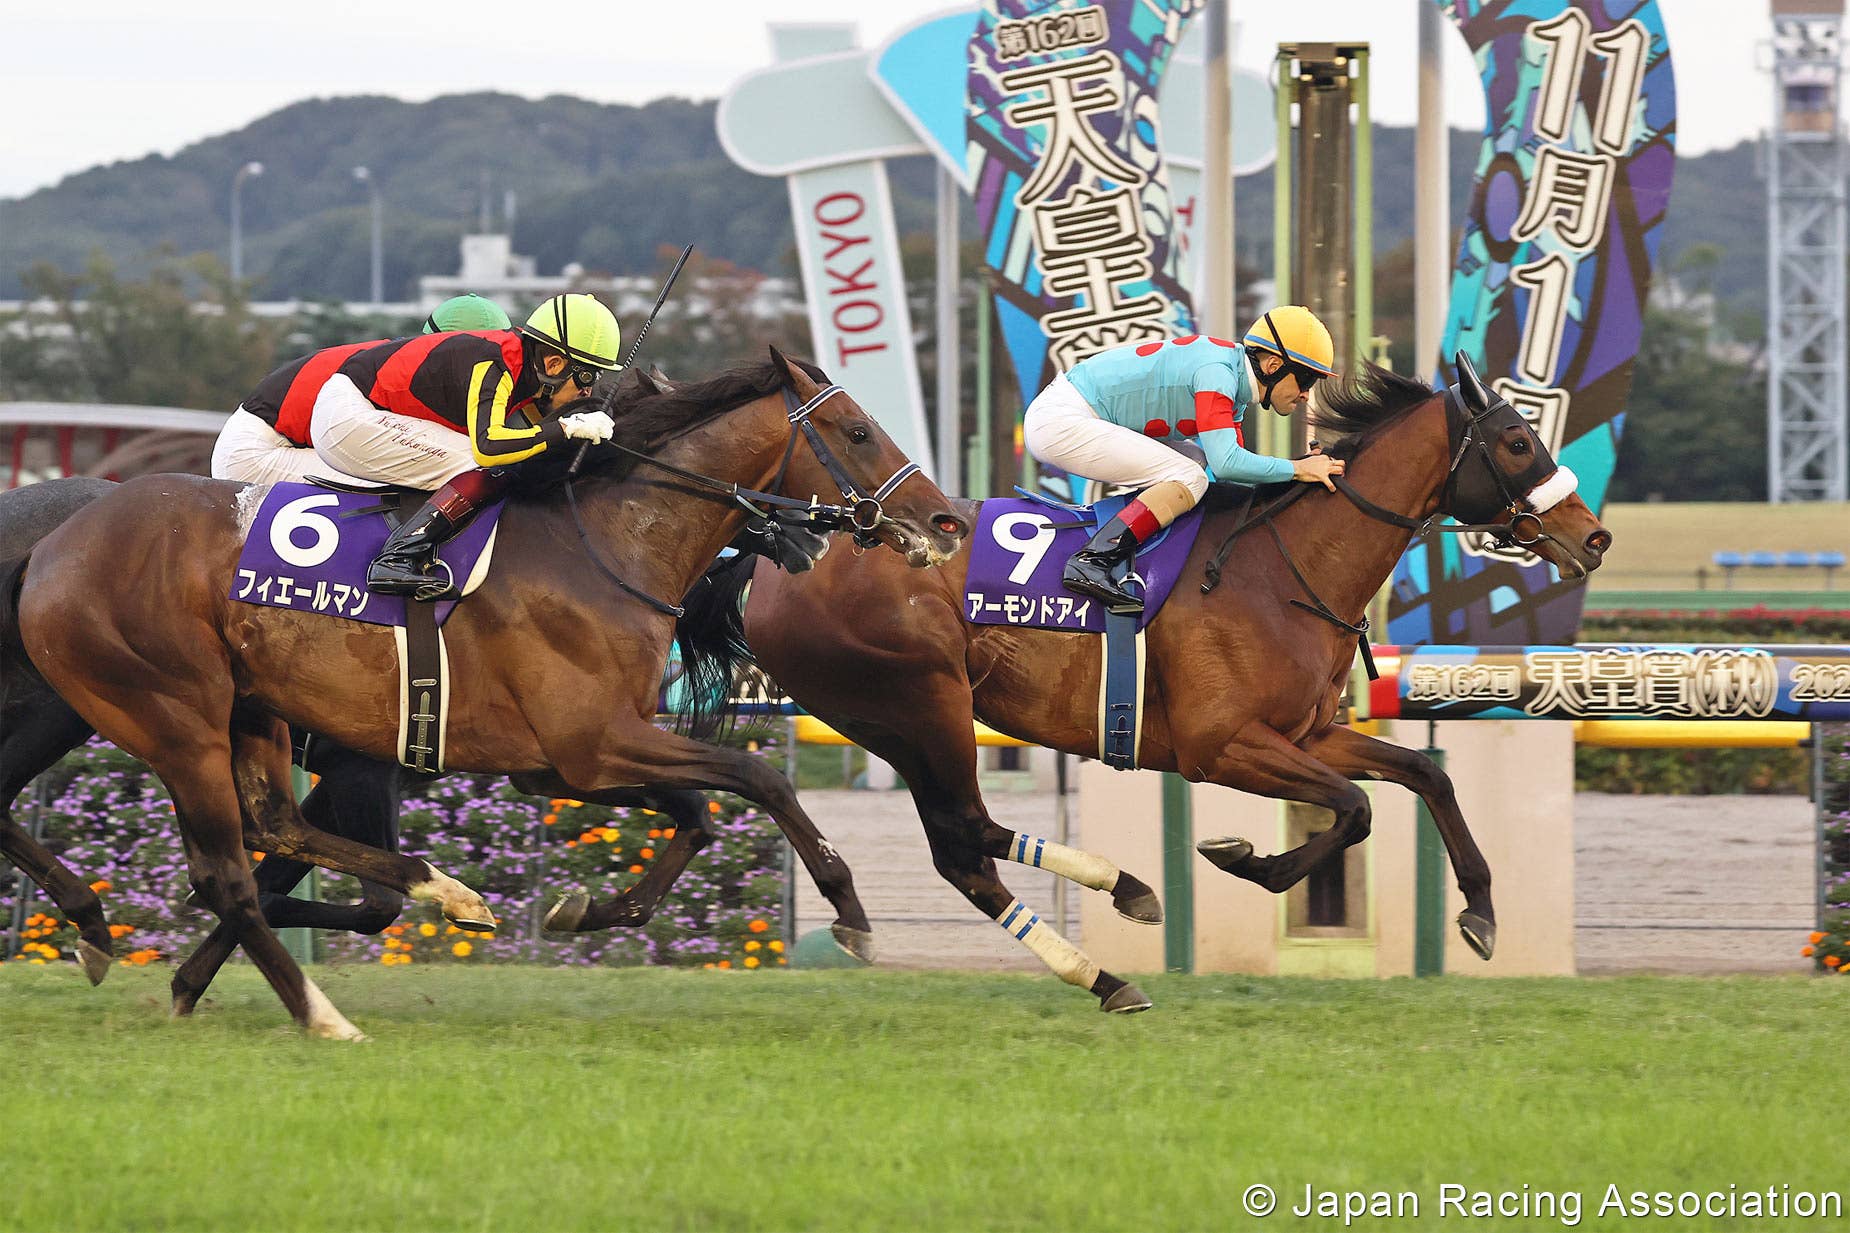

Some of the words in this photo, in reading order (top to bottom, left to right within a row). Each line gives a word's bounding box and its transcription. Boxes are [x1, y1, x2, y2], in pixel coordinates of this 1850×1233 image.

[814, 192, 888, 367] TOKYO
[270, 494, 340, 567] 6
[992, 512, 1056, 585] 9
[238, 568, 369, 617] フィエールマン
[967, 592, 1091, 627] アーモンドアイ
